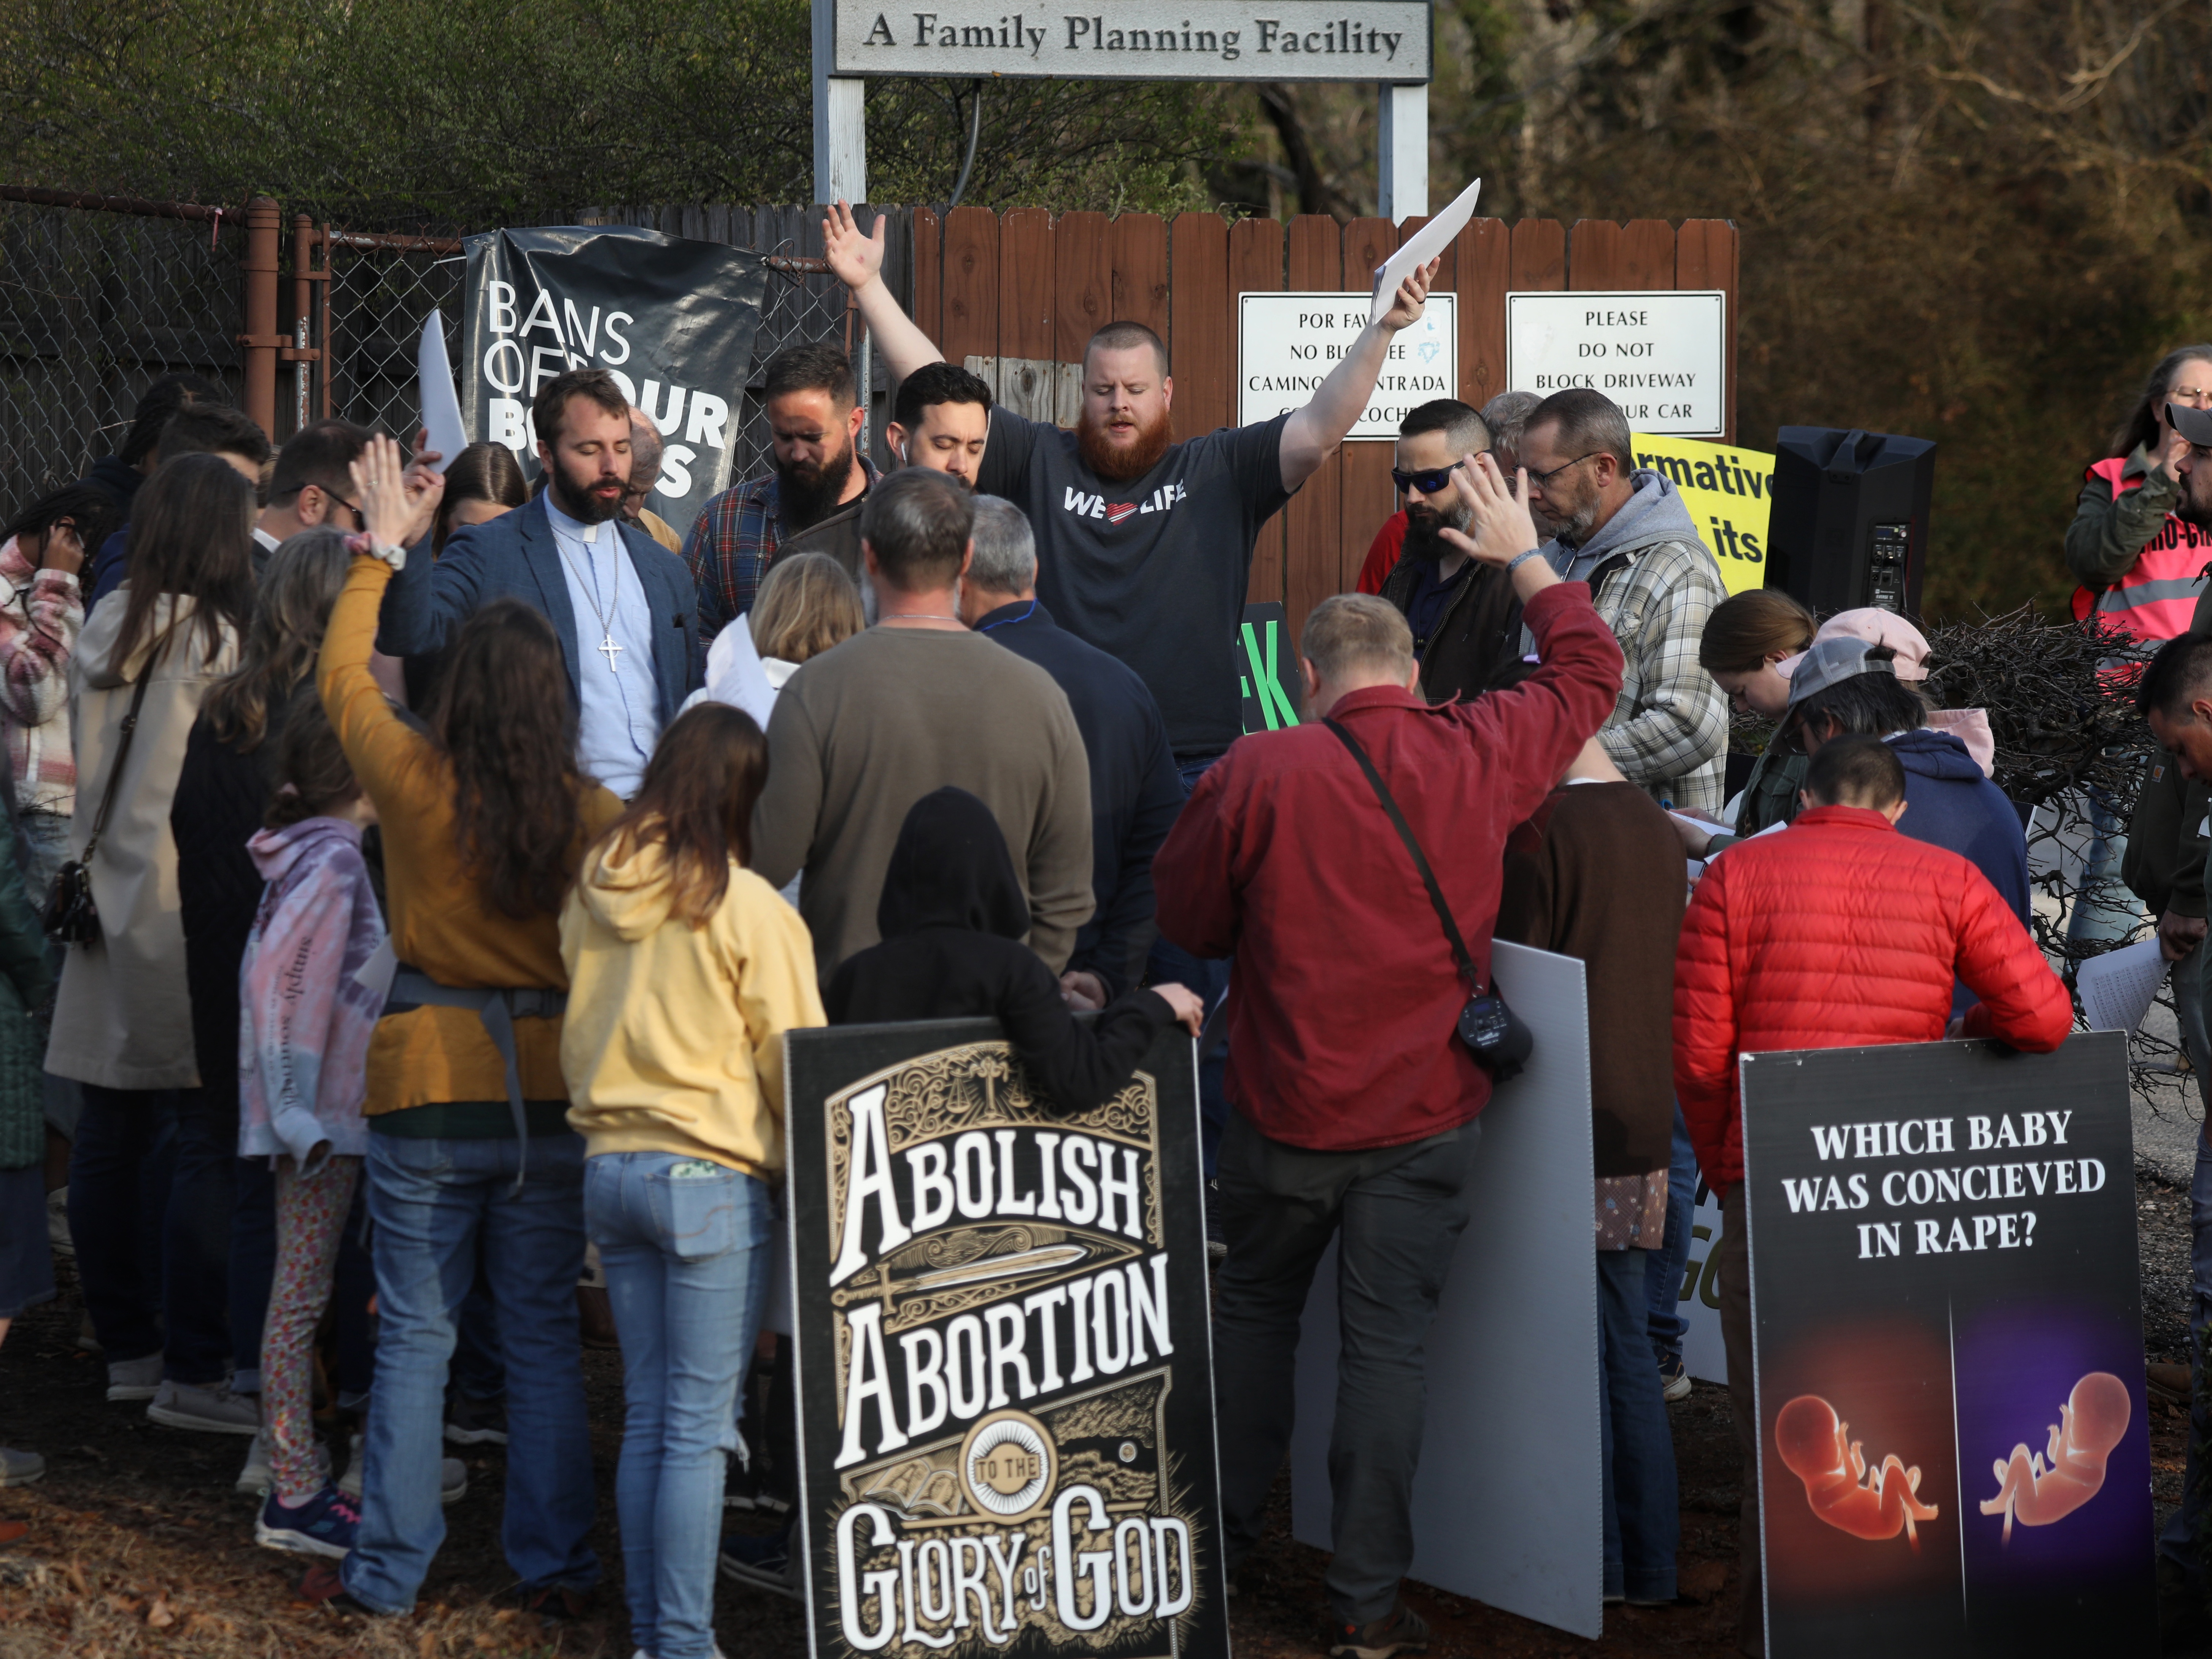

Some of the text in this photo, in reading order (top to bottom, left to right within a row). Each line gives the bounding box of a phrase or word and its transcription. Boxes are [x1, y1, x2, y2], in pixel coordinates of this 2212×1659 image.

[863, 13, 1403, 61] A Family Planning Facility
[488, 280, 634, 365] BANS
[1300, 313, 1334, 329] POR
[1586, 311, 1648, 326] PLEASE
[483, 339, 588, 398] OF
[1290, 345, 1317, 360] NO
[1579, 343, 1654, 357] DO NOT
[1377, 376, 1445, 391] NTRADA
[1537, 373, 1696, 388] BLOCK DRIVEWAY
[1658, 404, 1692, 418] CAR
[1064, 478, 1187, 519] WE LIFE
[1710, 516, 1763, 563] its
[1810, 1109, 2073, 1161] WHICH BABY
[830, 1084, 1143, 1287] ABOLISH
[1781, 1158, 2106, 1213] WAS CONCIEVED
[1857, 1211, 2037, 1259] IN RAPE?
[833, 1252, 1174, 1470] ABORTION
[977, 1457, 1039, 1481] TO THE
[837, 1484, 1193, 1651] GLORY of GOD
